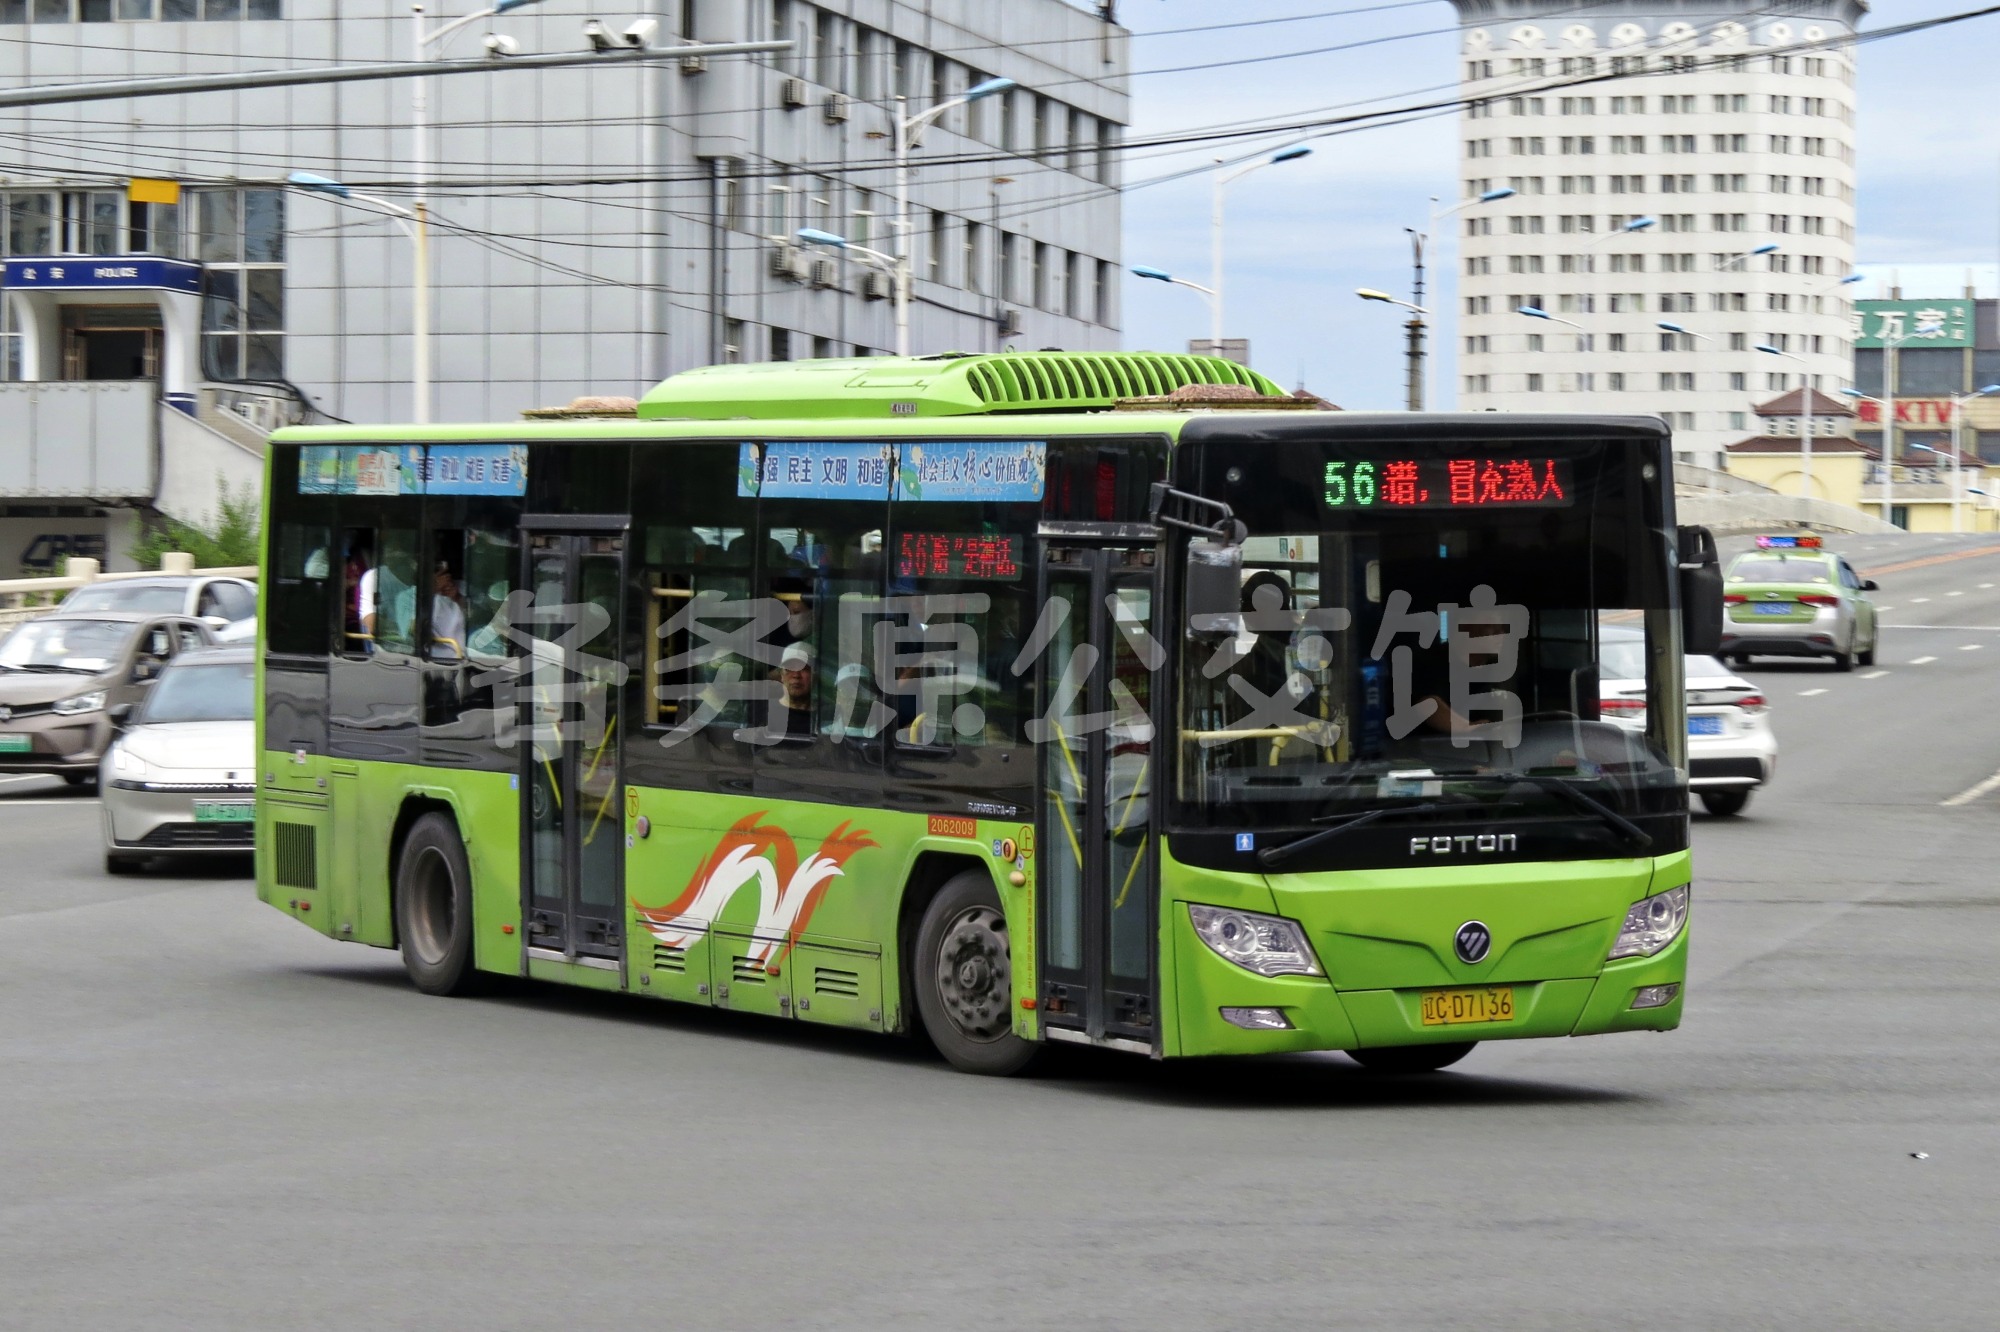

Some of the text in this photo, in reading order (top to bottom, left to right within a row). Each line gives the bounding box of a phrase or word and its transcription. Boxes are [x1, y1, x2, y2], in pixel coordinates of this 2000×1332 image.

[1895, 401, 1953, 423] KTV
[788, 457, 812, 483] 民主
[821, 457, 848, 485] 文明
[857, 458, 885, 485] 和谐
[918, 450, 1029, 484] 社会主义核心价值观
[1324, 461, 1375, 505] 56
[931, 818, 974, 835] 2062009
[1410, 833, 1517, 856] FOTON
